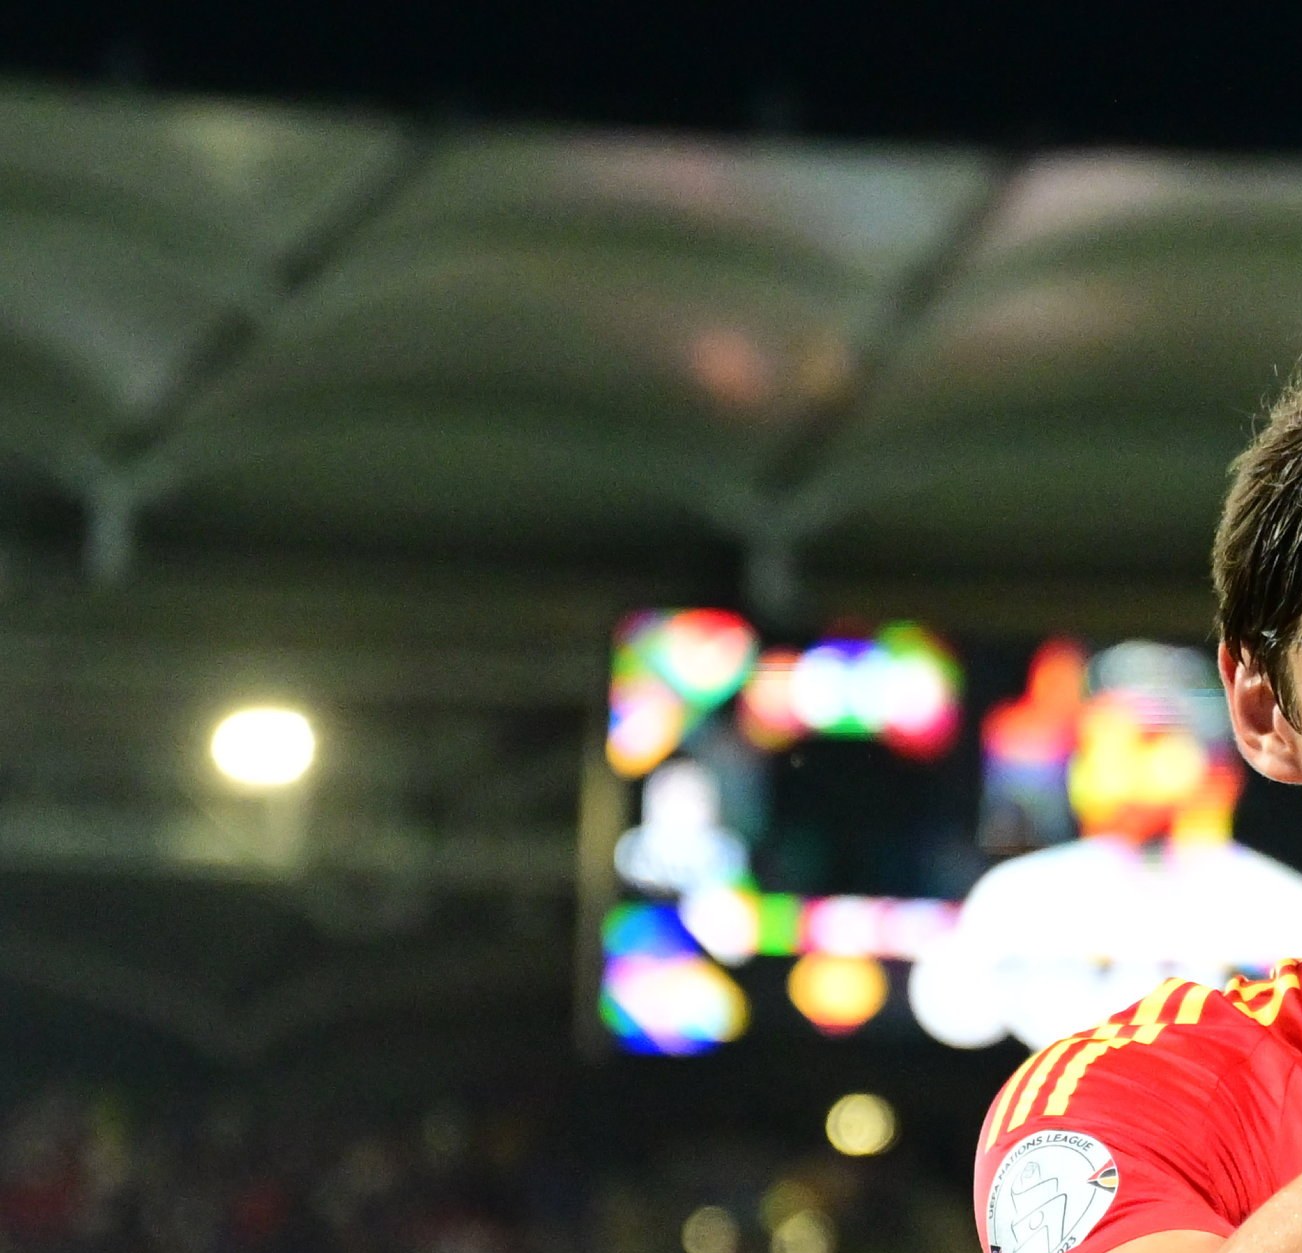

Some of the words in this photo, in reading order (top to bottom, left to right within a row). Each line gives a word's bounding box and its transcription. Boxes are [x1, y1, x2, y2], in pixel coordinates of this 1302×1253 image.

[988, 1184, 999, 1219] UEFA
[998, 1136, 1043, 1180] NATIONS
[1045, 1133, 1094, 1152] LEAGUE
